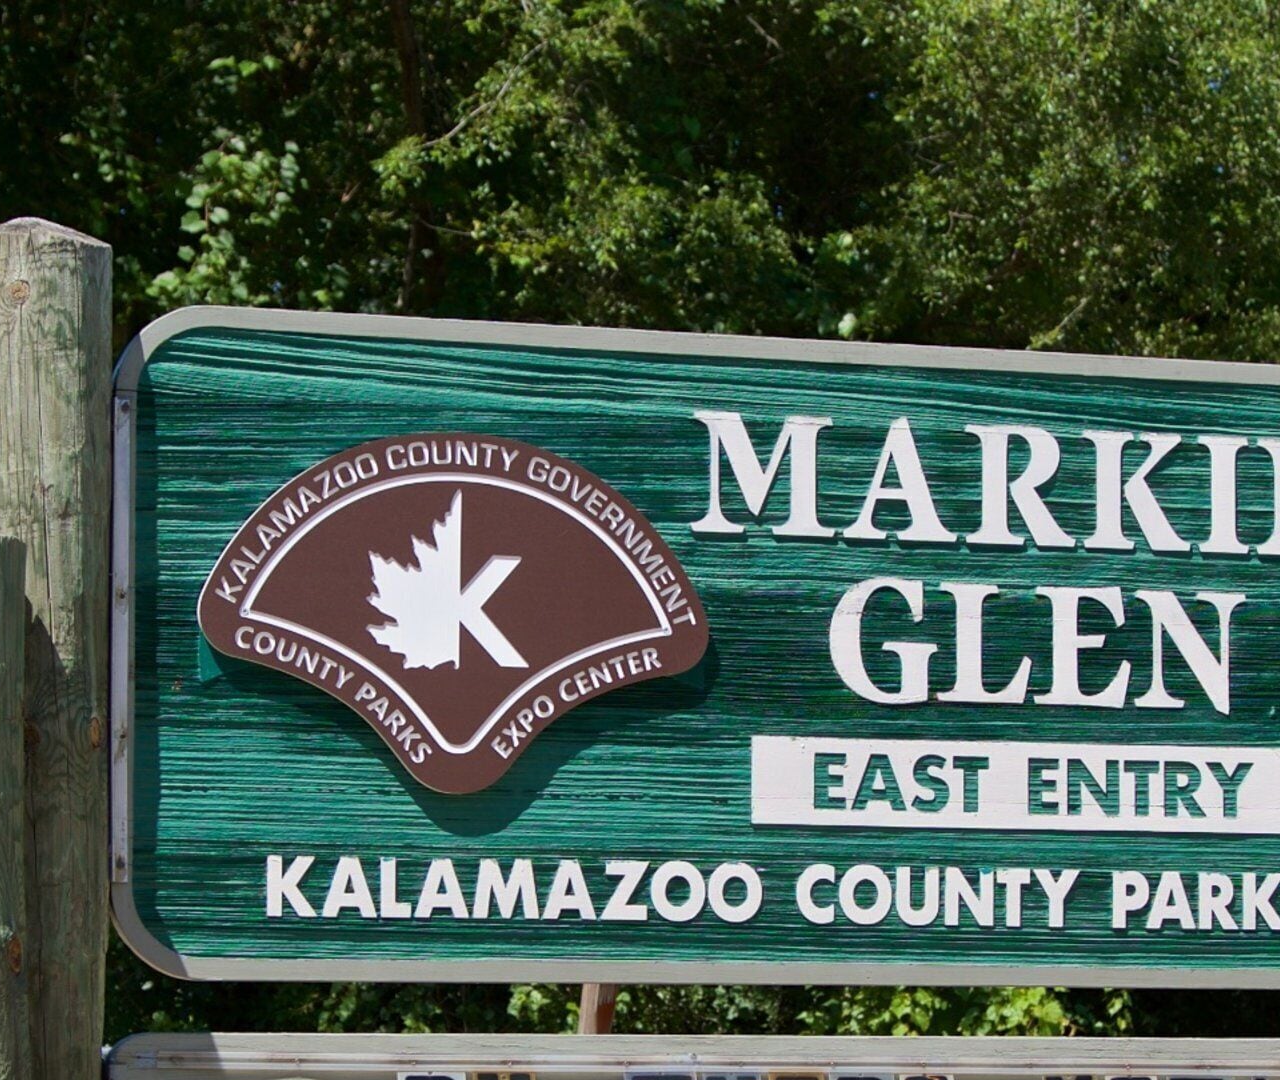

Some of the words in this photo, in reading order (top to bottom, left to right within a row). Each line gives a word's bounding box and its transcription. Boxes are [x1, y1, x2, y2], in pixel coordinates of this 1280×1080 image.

[214, 452, 379, 604] KALAMAZOO
[385, 440, 520, 473] COUNTY
[526, 455, 697, 628] GOVERNMENT
[233, 624, 355, 690] COUNTY
[353, 680, 433, 766] PARKS
[489, 693, 557, 760] EXPO
[557, 645, 662, 703] CENTER
[829, 576, 1247, 715] GLEN
[812, 751, 991, 814] EAST
[1026, 756, 1256, 819] ENTRY
[265, 855, 763, 923] KALAMAZOO
[795, 862, 1081, 929] COUNTY
